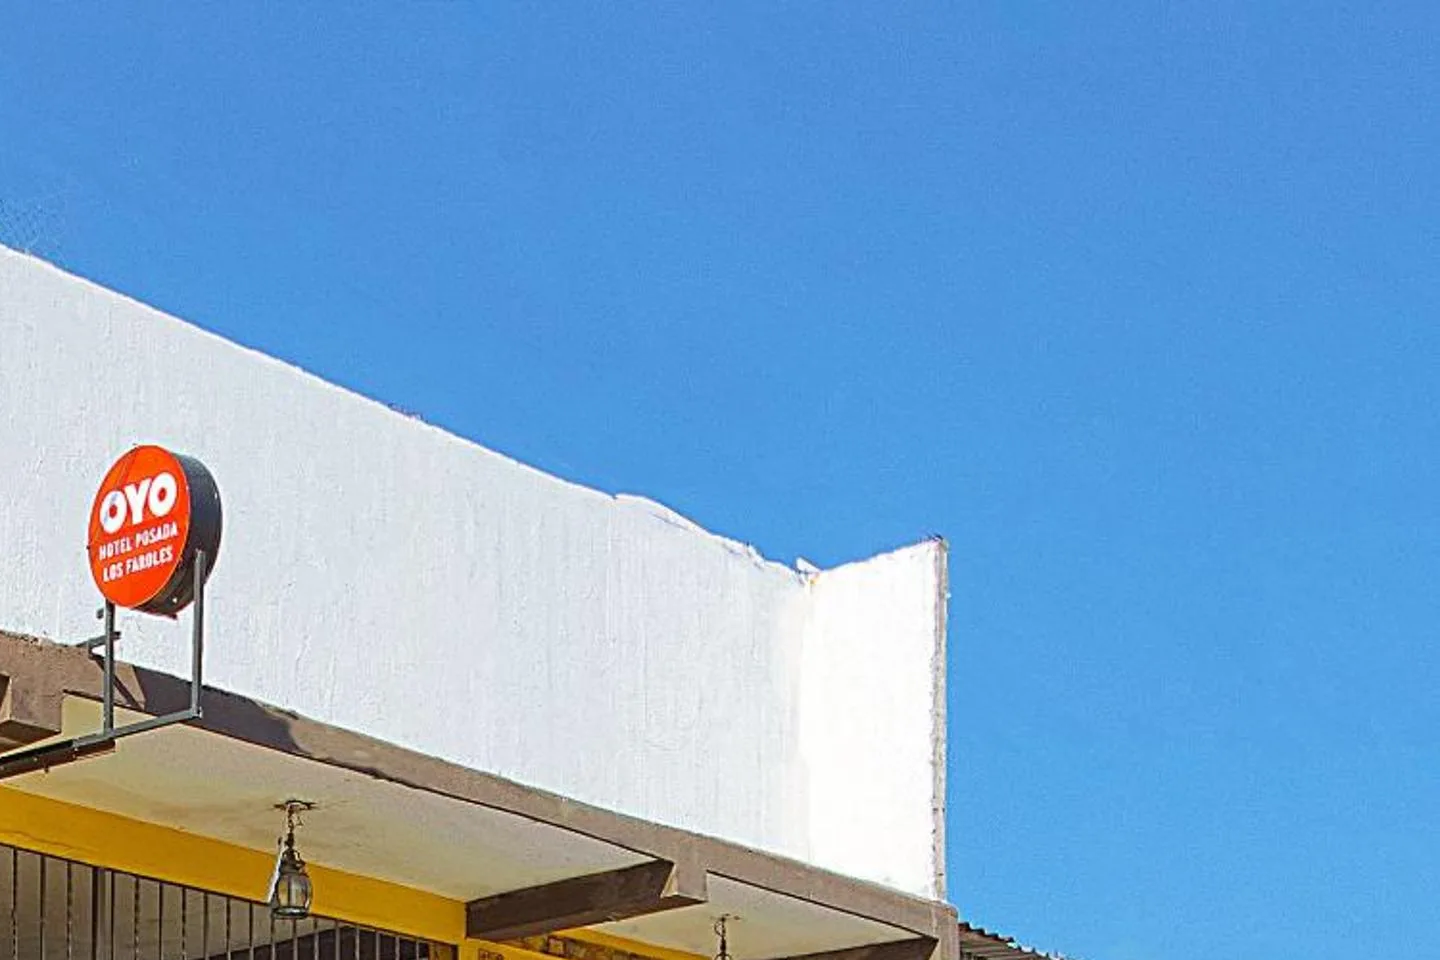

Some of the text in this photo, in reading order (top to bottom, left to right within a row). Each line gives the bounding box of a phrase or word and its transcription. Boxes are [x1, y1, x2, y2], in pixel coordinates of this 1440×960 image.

[100, 472, 177, 533] OYO
[99, 522, 178, 560] HOTEL POSADA
[104, 547, 172, 581] LOS FAROLES
